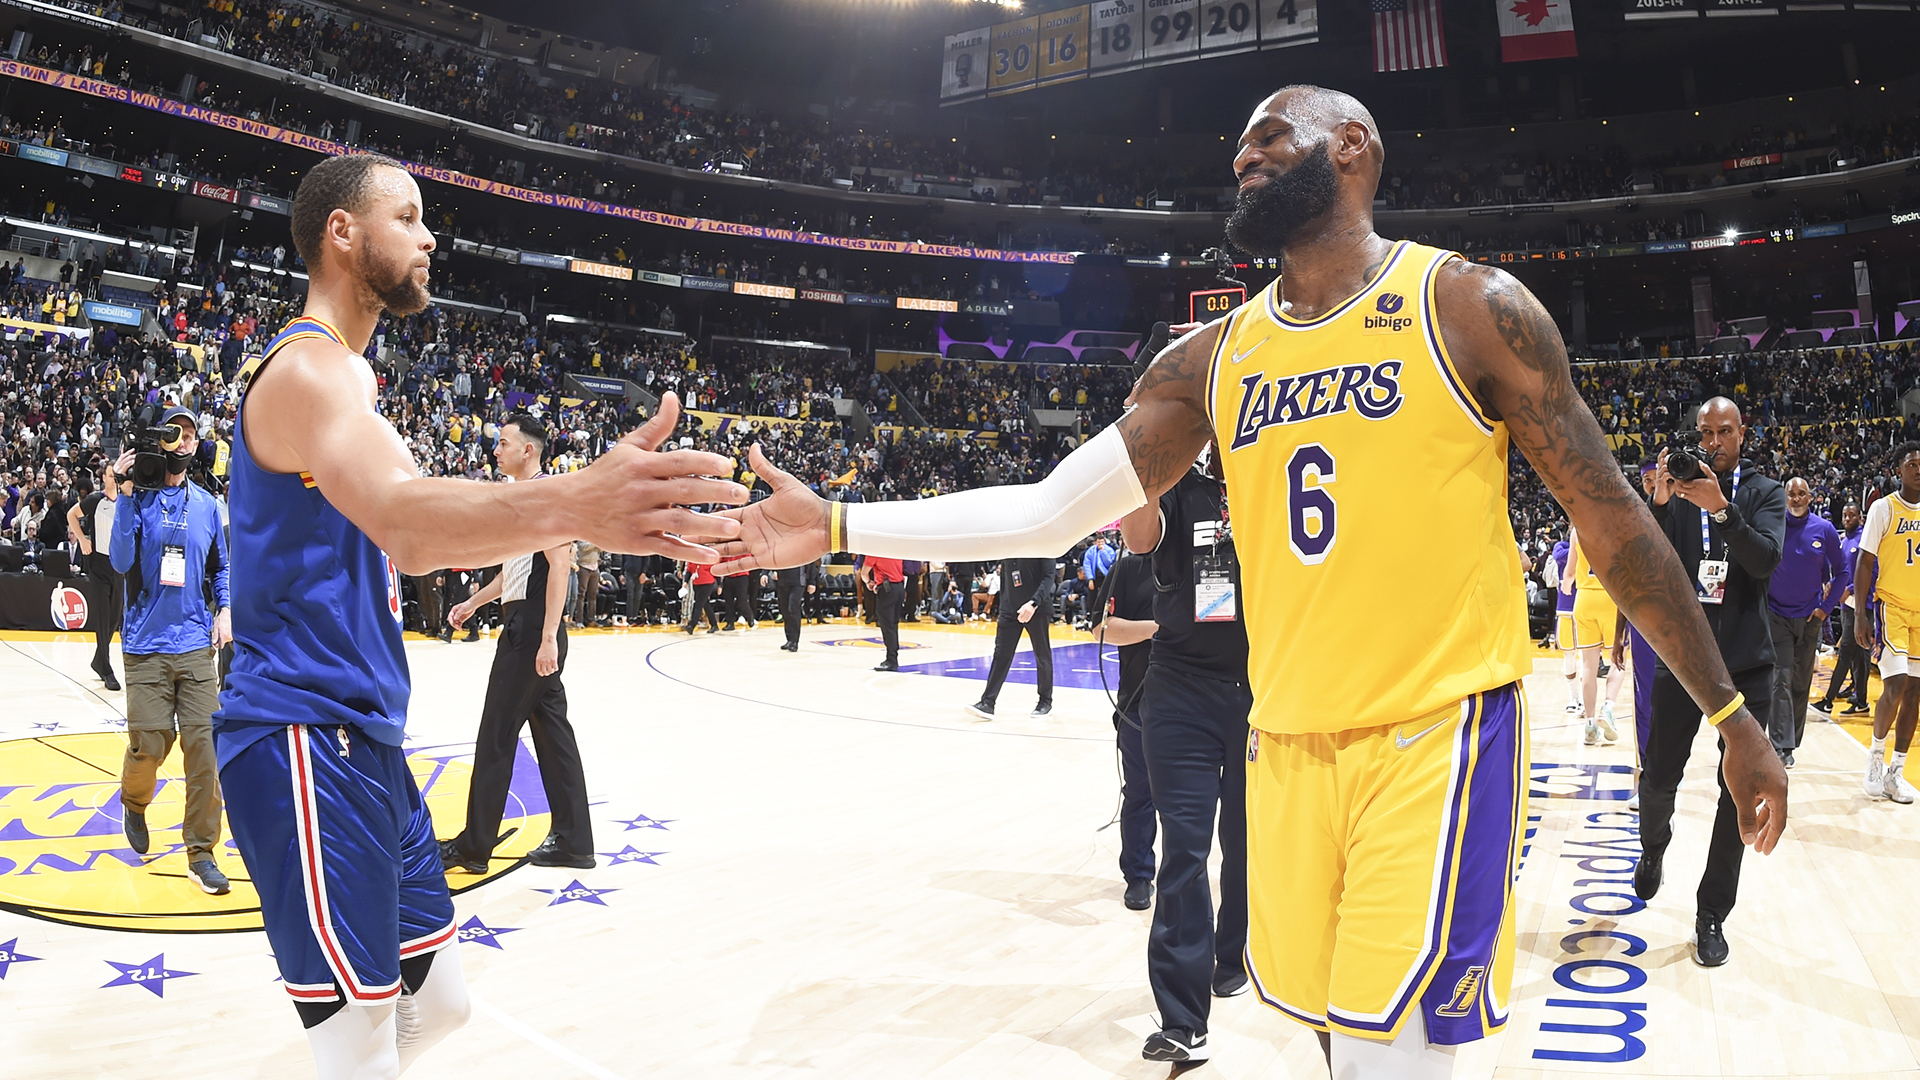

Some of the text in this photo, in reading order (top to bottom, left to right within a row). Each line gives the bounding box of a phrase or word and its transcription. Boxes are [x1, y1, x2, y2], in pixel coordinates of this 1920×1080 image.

[1100, 4, 1134, 19] TAYLOR
[1206, 2, 1250, 36] 20
[1276, 0, 1298, 25] 4
[1046, 14, 1082, 30] DIONNE
[1150, 10, 1192, 46] 99
[996, 26, 1033, 40] VACHON
[1101, 23, 1132, 55] 18
[951, 36, 982, 50] MILLER
[1048, 32, 1078, 66] 16
[996, 44, 1030, 77] 30
[20, 66, 49, 81] WIN
[70, 78, 128, 102] LAKERS
[130, 90, 160, 110] WIN
[181, 104, 238, 128] LAKERS
[241, 121, 270, 136] WIN
[290, 134, 345, 156] LAKERS
[26, 147, 60, 160] mobilitie
[121, 173, 142, 182] FOULS
[124, 167, 142, 176] TEAM
[155, 172, 167, 182] LAL
[171, 176, 188, 186] GSW
[200, 184, 229, 200] Coca-Cola
[260, 200, 278, 209] TOYOTA
[405, 162, 1074, 263] AKERS WIN LAKERS WIN LAKERS WIN LAKERS WIN LAKERS WIN LAKERS WIN LAKERS
[1552, 250, 1566, 260] 116
[576, 262, 629, 279] LAKERS
[691, 280, 729, 290] crypto.com
[739, 283, 791, 298] LAKERS
[801, 290, 844, 303] TOSHIBA
[1207, 295, 1229, 311] 0.0
[92, 305, 132, 318] mobilitie
[902, 298, 954, 312] LAKERS
[976, 306, 1005, 314] DELTA
[1364, 316, 1412, 331] bibigo
[1230, 359, 1406, 453] LAKERS
[1285, 442, 1337, 566] 6
[74, 604, 83, 613] NBA
[1532, 812, 1648, 1063] crypto.com
[126, 967, 170, 982] '72
